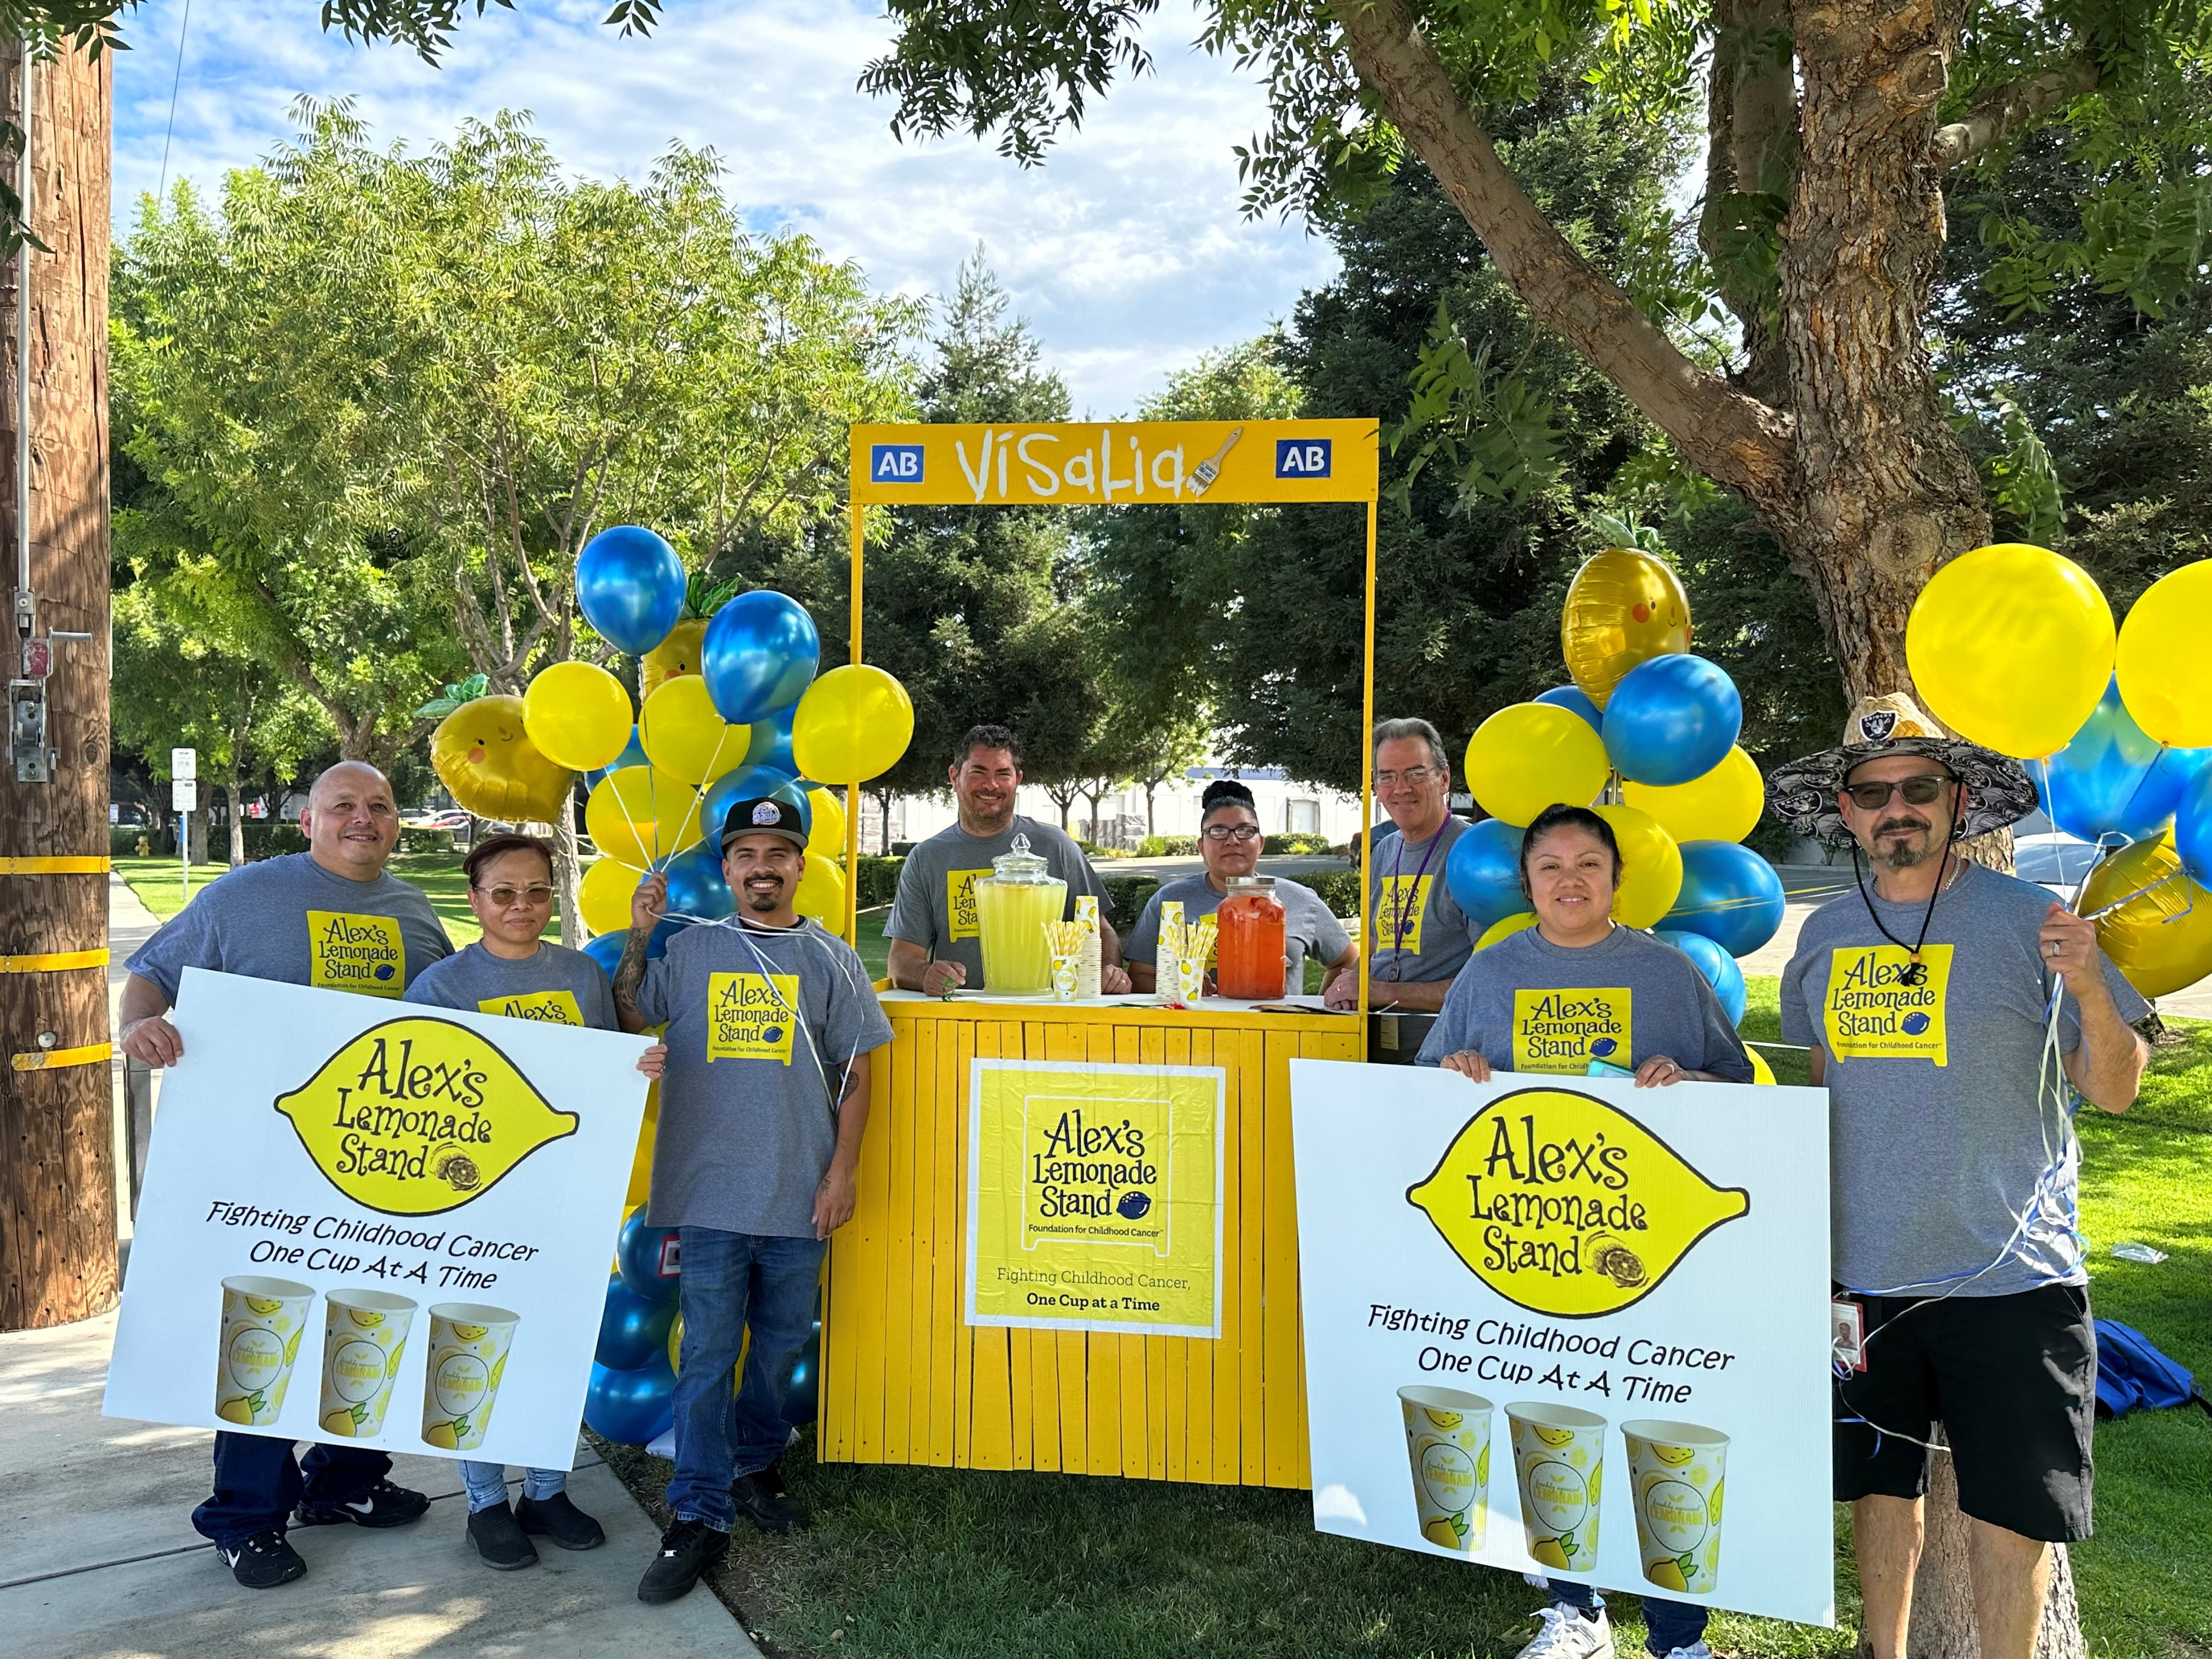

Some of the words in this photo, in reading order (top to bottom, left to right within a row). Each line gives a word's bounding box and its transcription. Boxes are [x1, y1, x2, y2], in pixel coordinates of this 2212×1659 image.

[878, 452, 918, 476] AB
[1282, 447, 1325, 471] AB
[323, 917, 388, 945] Alex's
[958, 910, 978, 925] Sta
[318, 940, 398, 963] Lemonade
[324, 959, 371, 979] Stand
[1844, 952, 1928, 991] Alexs
[720, 978, 782, 1007] Alexs
[1831, 987, 1936, 1011] Lemonade
[714, 1005, 788, 1025] Lemonade
[1531, 994, 1612, 1022] Alex's
[719, 1023, 760, 1042] Stand
[1521, 1019, 1622, 1037] Lemonade
[1838, 1011, 1897, 1036] Stand
[1527, 1036, 1585, 1058] Stand
[357, 1038, 487, 1108] Alex's
[333, 1087, 492, 1143] Lemonade
[1043, 1109, 1145, 1158] Alex's
[336, 1133, 428, 1180] Stand
[1483, 1115, 1628, 1190] Alex's
[1032, 1154, 1157, 1189] Lemonade
[1040, 1186, 1113, 1218] Stand
[1466, 1175, 1648, 1231] Lemonade
[206, 1201, 311, 1234] Fighting
[313, 1216, 446, 1251] Childhood
[448, 1235, 539, 1261] Cancer
[1029, 1224, 1074, 1233] Foundation
[1075, 1225, 1087, 1233] for
[1088, 1226, 1130, 1235] Childhood
[250, 1240, 304, 1262] One
[307, 1248, 360, 1273] Cup
[362, 1256, 403, 1279] At
[403, 1261, 428, 1284] A
[439, 1266, 497, 1289] Time
[1483, 1225, 1582, 1277] Stand
[997, 1268, 1057, 1285] Fighting
[1061, 1271, 1133, 1286] Childhood
[1138, 1274, 1190, 1290] Cancer,
[1027, 1293, 1056, 1306] One
[1059, 1295, 1089, 1310] Cup
[1092, 1297, 1107, 1308] at
[1110, 1299, 1119, 1308] a
[1122, 1297, 1160, 1311] Time
[1368, 1305, 1471, 1340] Fighting
[1476, 1320, 1621, 1358] Childhood
[1628, 1339, 1735, 1370] Cancer
[1418, 1347, 1472, 1372] One
[1477, 1356, 1532, 1384] Cup
[1538, 1364, 1580, 1391] At
[1584, 1370, 1611, 1397] A
[1622, 1376, 1692, 1403] Time
